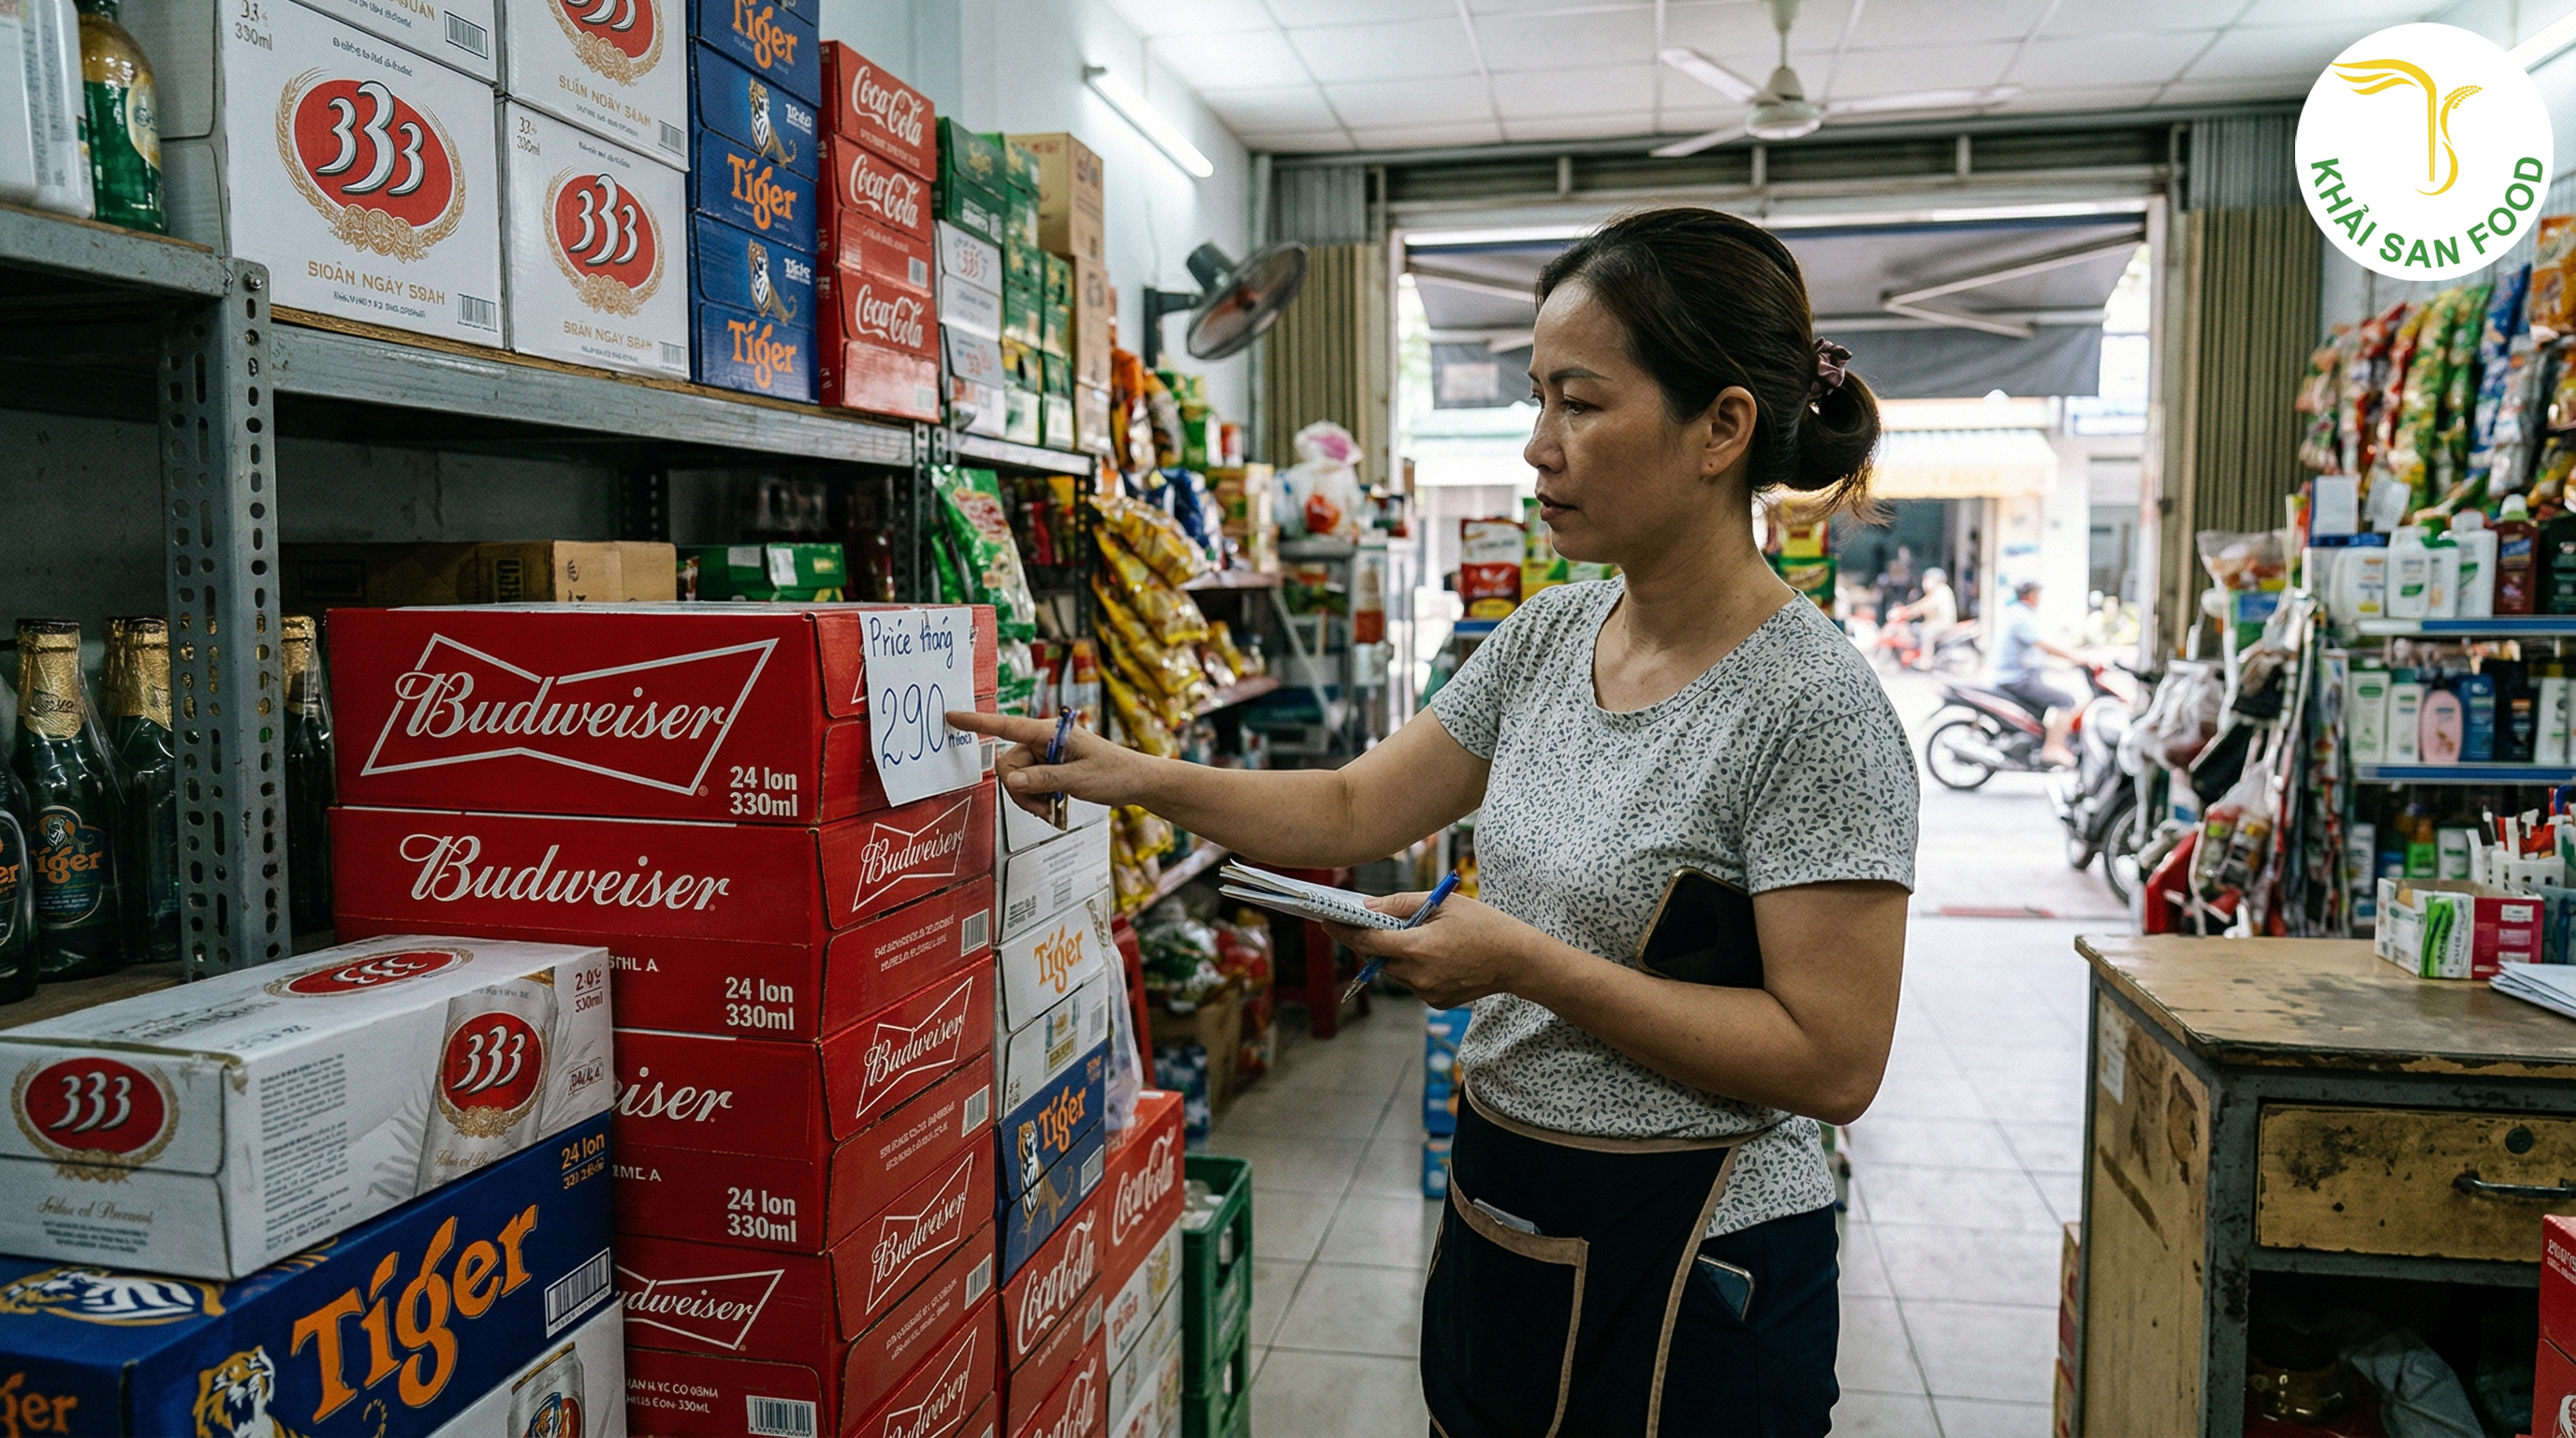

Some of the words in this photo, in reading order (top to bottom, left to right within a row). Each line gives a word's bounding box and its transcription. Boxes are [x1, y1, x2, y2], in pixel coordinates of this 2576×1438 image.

[731, 0, 798, 68] Tiger
[315, 81, 424, 197] 333
[852, 66, 925, 147] Coca-Cola
[569, 173, 638, 266] 333
[727, 154, 798, 230] Tiger
[850, 154, 920, 229] Coca-Cola
[855, 284, 925, 349] Coca-Cola
[727, 319, 798, 389] Tiger
[395, 671, 729, 740] Budweiser
[882, 683, 945, 770] 290
[730, 766, 758, 788] 24
[764, 767, 798, 790] lon
[730, 791, 798, 816] 330ml
[30, 845, 103, 884] iger
[400, 833, 729, 910] Budweiser
[861, 829, 963, 884] Budweiser
[725, 976, 753, 1001] 24
[759, 978, 794, 1003] lon
[1033, 924, 1084, 994] Tiger
[725, 1003, 795, 1031] 330ml
[864, 1014, 964, 1087] Budweiser
[451, 1024, 526, 1095] 333
[49, 1072, 133, 1133] 333
[1038, 1085, 1088, 1153] Tiger
[562, 1142, 579, 1169] 24
[582, 1133, 606, 1158] lon
[1112, 1124, 1178, 1247] Coca-Cola
[726, 1187, 754, 1211] 24
[761, 1190, 796, 1216] lon
[726, 1213, 797, 1242] 330ml
[871, 1192, 967, 1284] Budweiser
[291, 1203, 540, 1425] Tiger
[615, 1279, 754, 1321] dweiser
[1017, 1208, 1098, 1355] Coca-Cola
